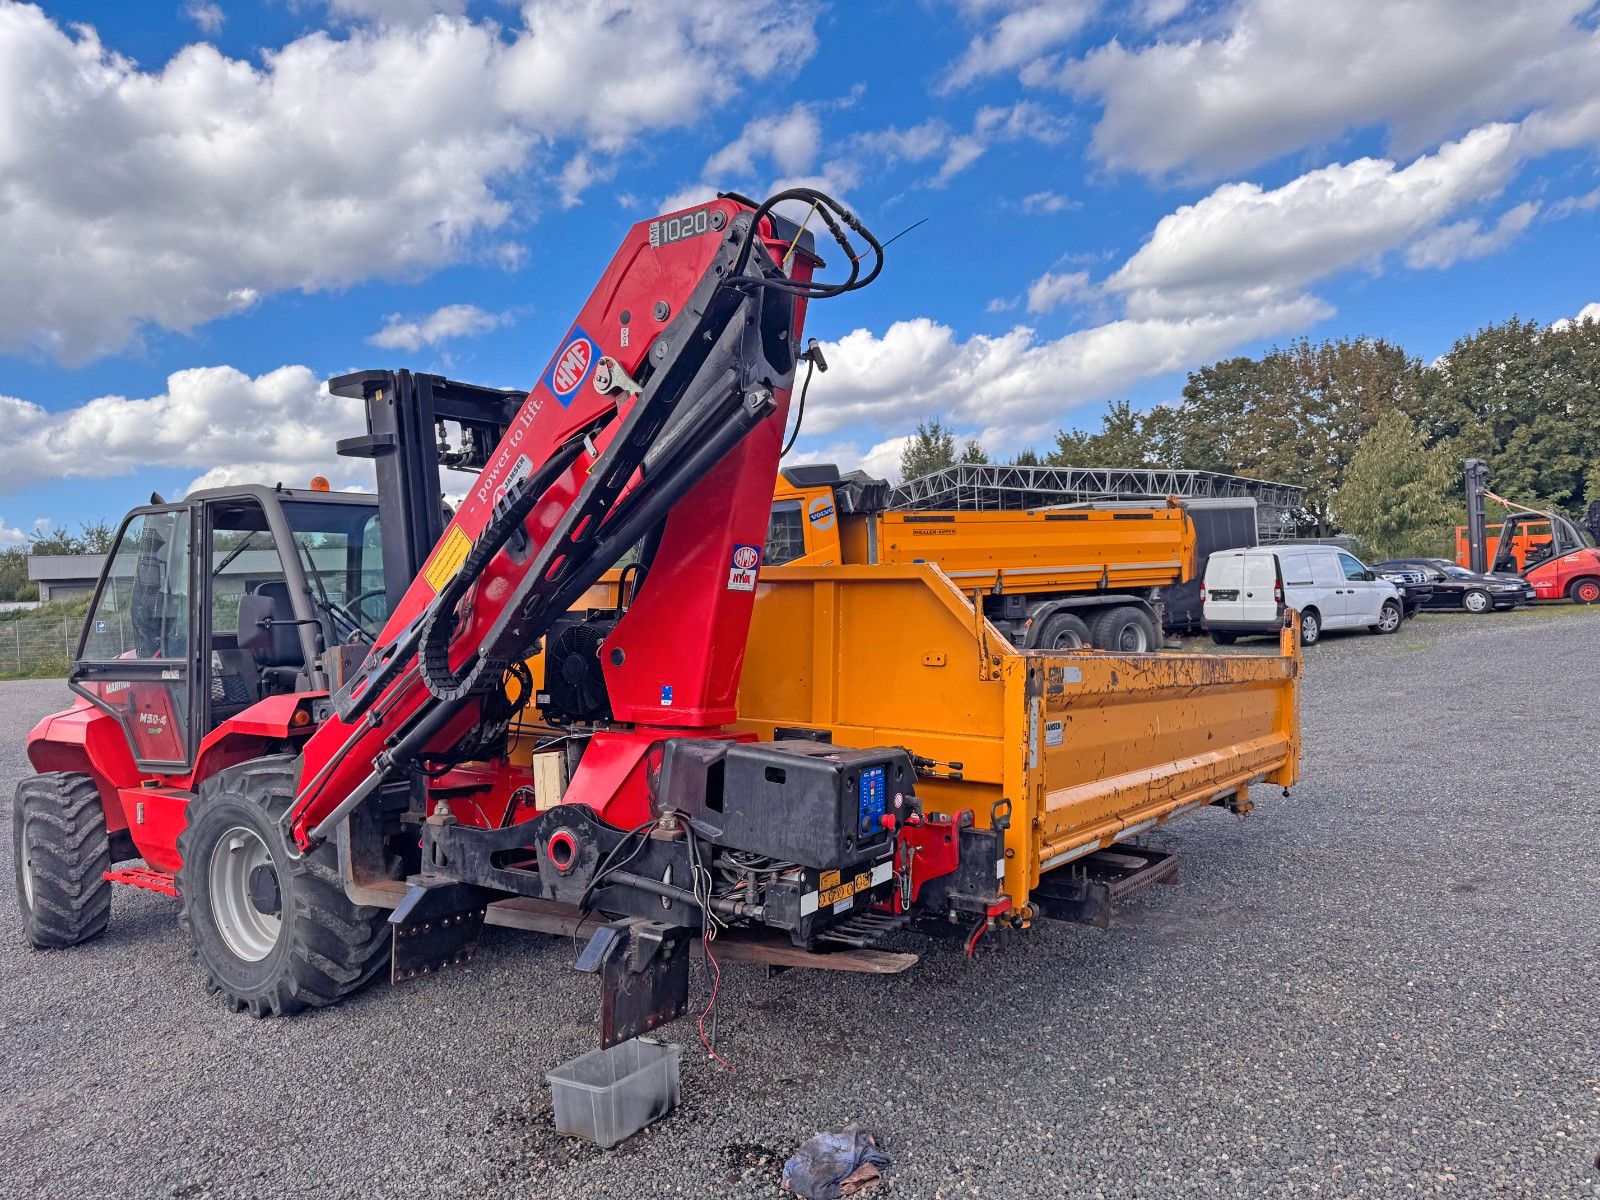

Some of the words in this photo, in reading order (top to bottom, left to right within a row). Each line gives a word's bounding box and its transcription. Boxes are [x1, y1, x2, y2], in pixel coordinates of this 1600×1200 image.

[662, 211, 708, 242] 1020
[556, 343, 587, 390] HMF
[478, 448, 511, 504] power
[510, 430, 523, 448] to
[520, 399, 544, 428] lift.
[810, 505, 834, 520] VOLVO
[735, 549, 756, 567] HMF
[139, 712, 167, 726] M30-4
